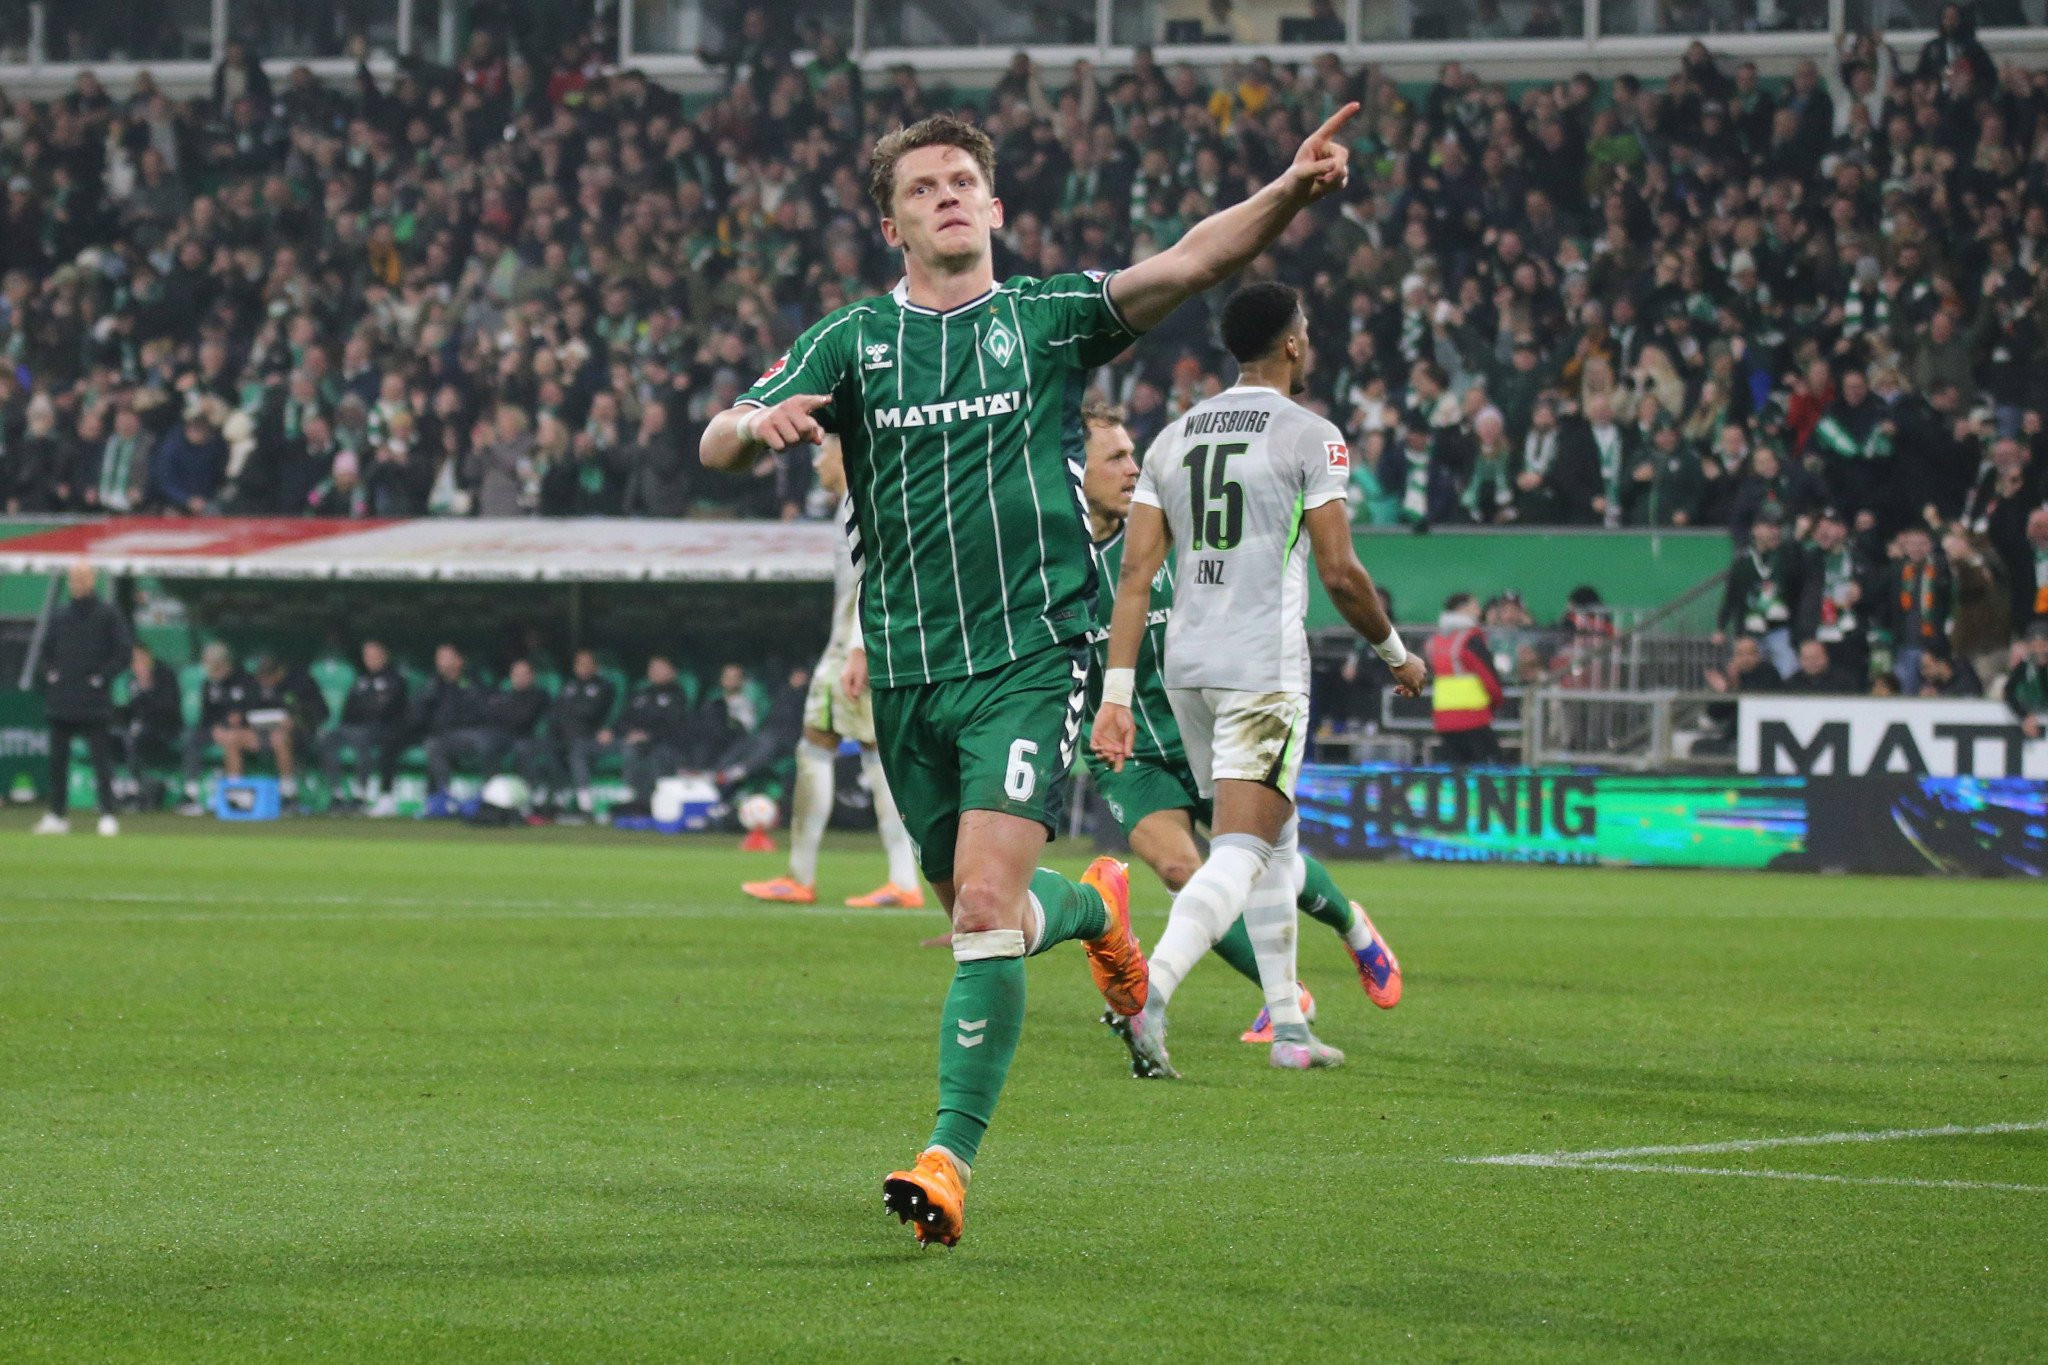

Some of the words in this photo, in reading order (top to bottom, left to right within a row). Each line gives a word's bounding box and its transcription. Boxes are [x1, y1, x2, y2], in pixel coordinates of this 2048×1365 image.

[874, 390, 1020, 429] MATTHÄI
[1184, 411, 1270, 438] WOLFSBURG
[1182, 443, 1249, 551] 15
[1194, 560, 1225, 585] ENZ
[1004, 738, 1038, 802] 6
